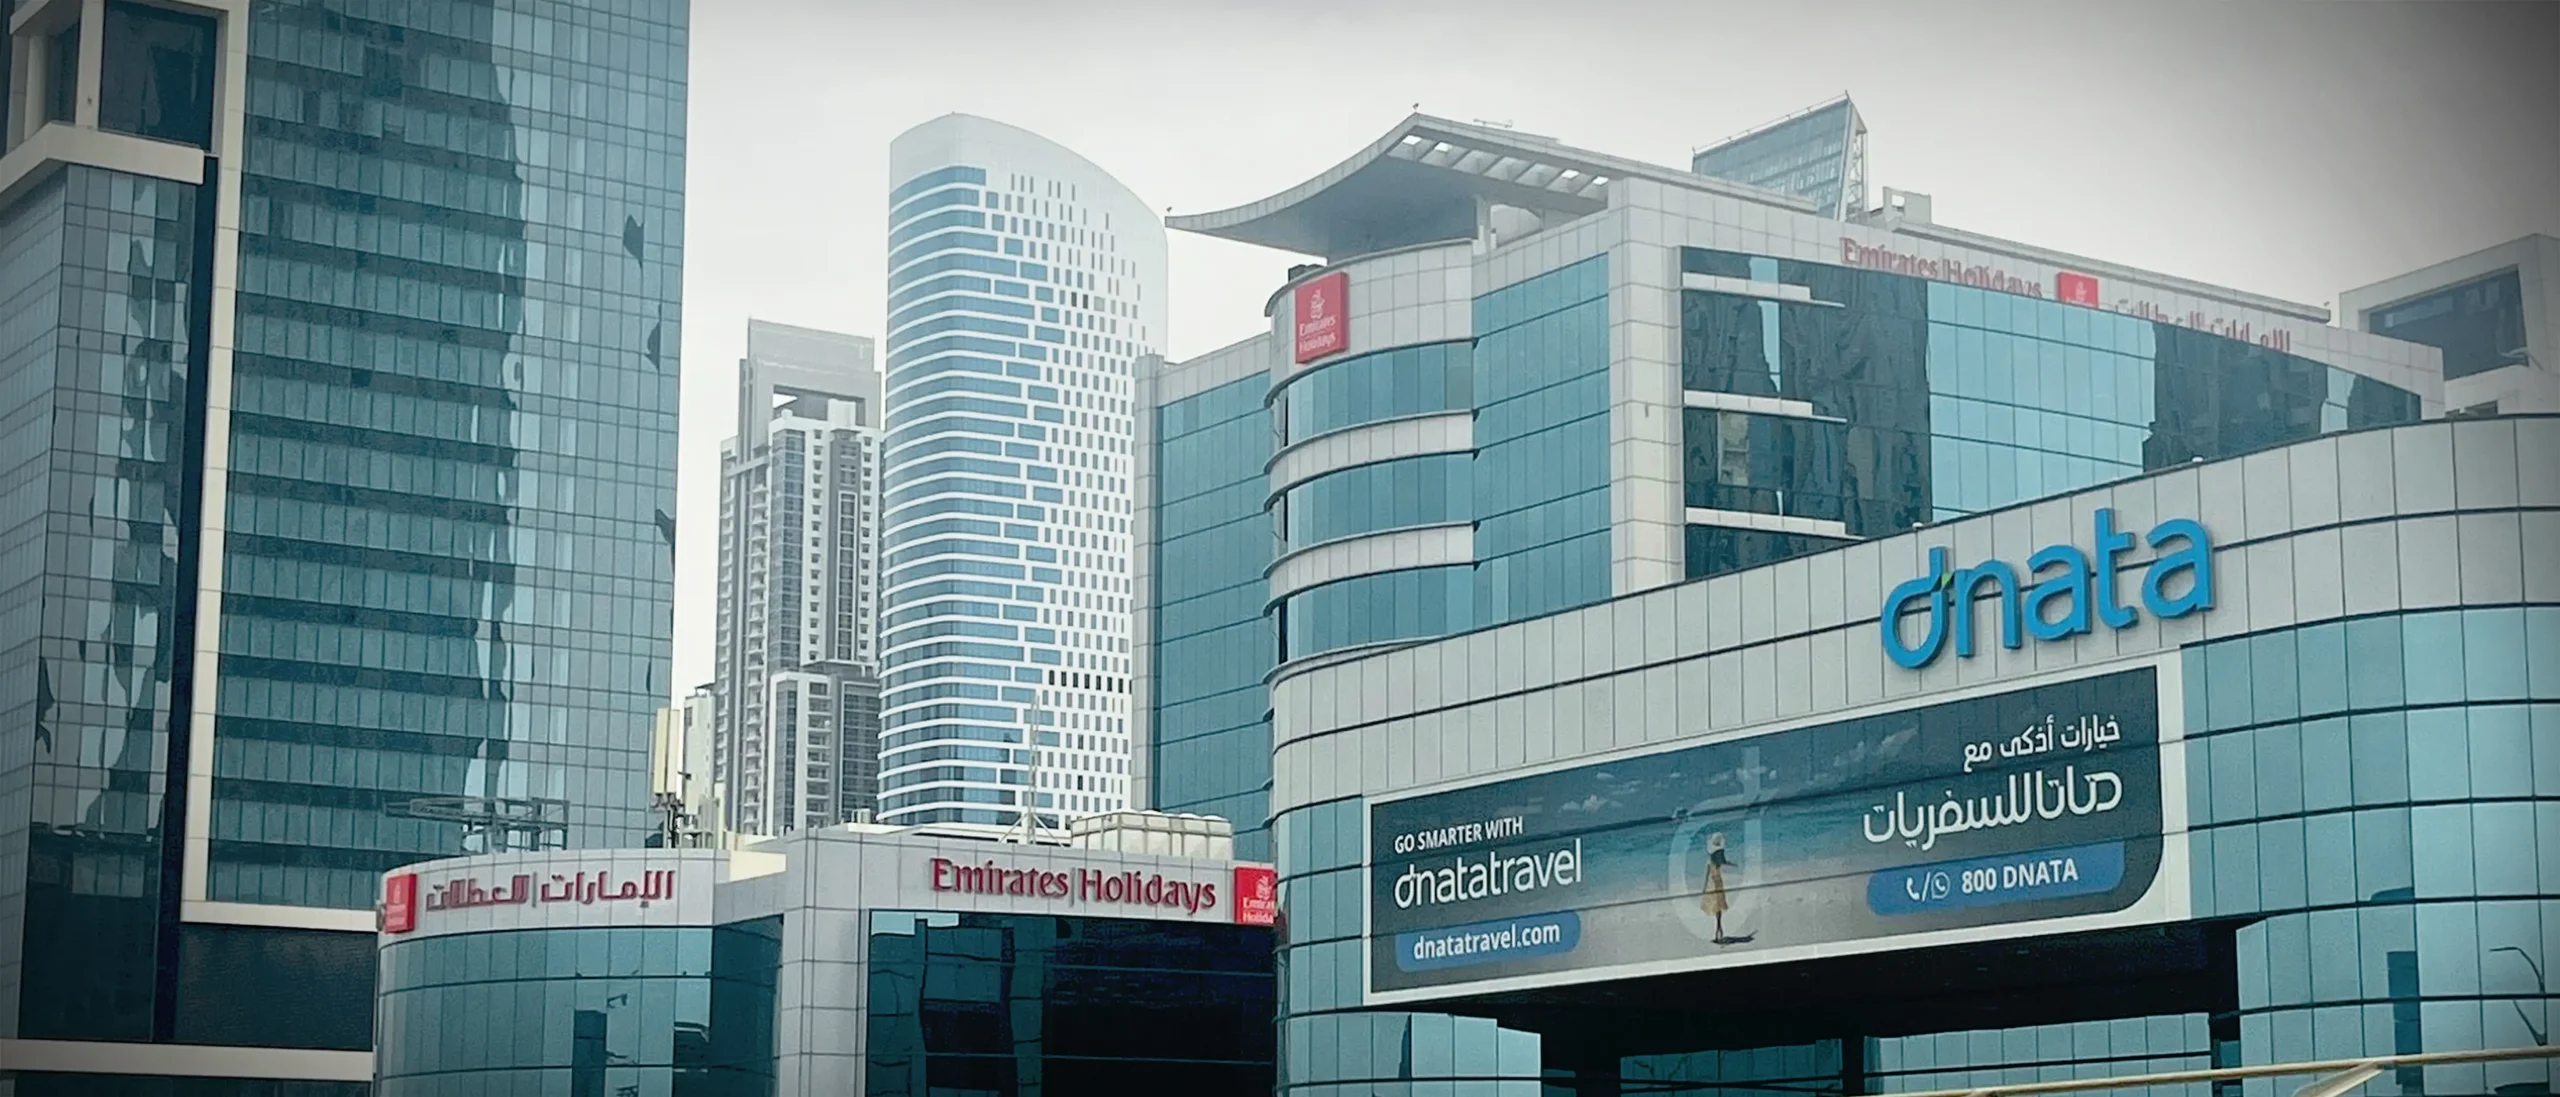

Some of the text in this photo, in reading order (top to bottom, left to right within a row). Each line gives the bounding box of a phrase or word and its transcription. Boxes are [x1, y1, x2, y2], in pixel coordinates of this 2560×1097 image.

[1840, 237, 1937, 279] Emirates
[1881, 508, 2215, 670] dnata
[1963, 714, 2121, 773] خيارات أذكى مع
[1394, 815, 1524, 854] GO SMARTER WITH
[930, 857, 1217, 915] Emirates Holidays
[1394, 838, 1582, 909] dnatatravel
[1962, 857, 2079, 894] 800 DNATA
[1413, 923, 1561, 960] dnatatravel.com
